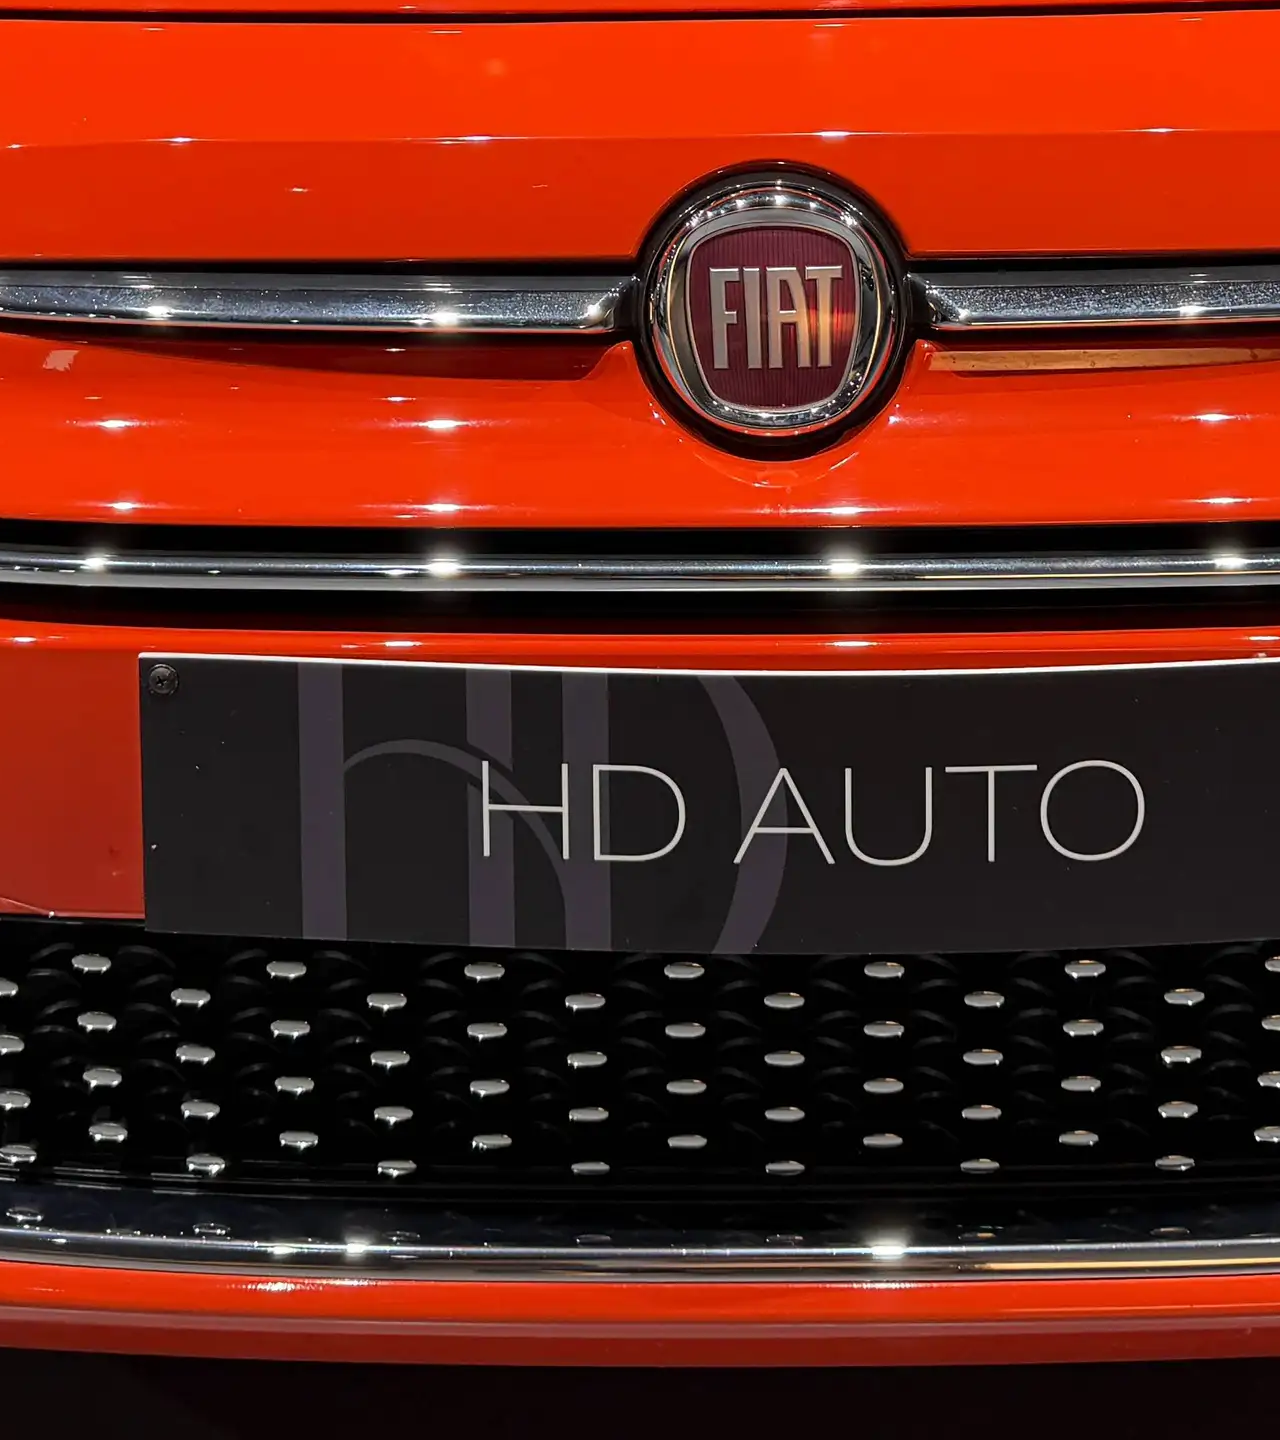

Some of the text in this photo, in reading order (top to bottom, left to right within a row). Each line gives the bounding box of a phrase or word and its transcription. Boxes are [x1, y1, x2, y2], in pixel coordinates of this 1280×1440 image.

[709, 265, 843, 369] FIAT
[481, 760, 1146, 866] HD AUTO
